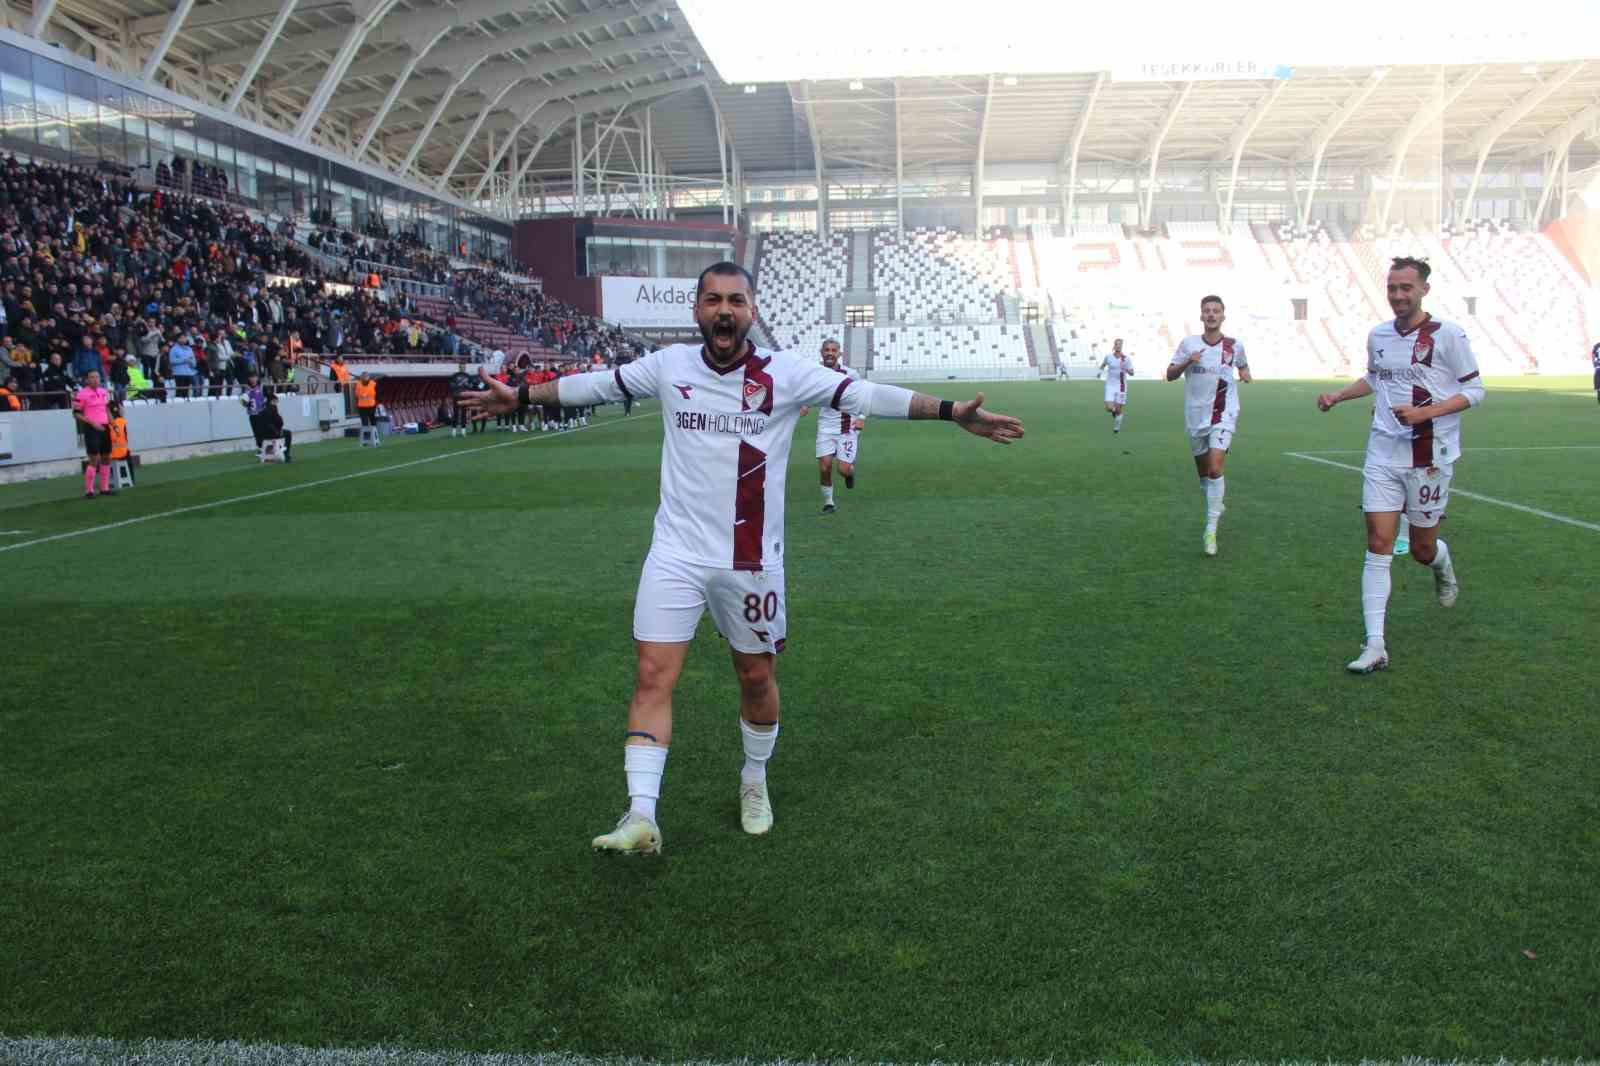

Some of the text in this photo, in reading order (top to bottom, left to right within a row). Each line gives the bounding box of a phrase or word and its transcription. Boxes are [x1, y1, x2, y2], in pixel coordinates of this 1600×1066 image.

[708, 415, 764, 435] HOLDING
[1419, 484, 1441, 506] 94
[743, 590, 777, 624] 80
